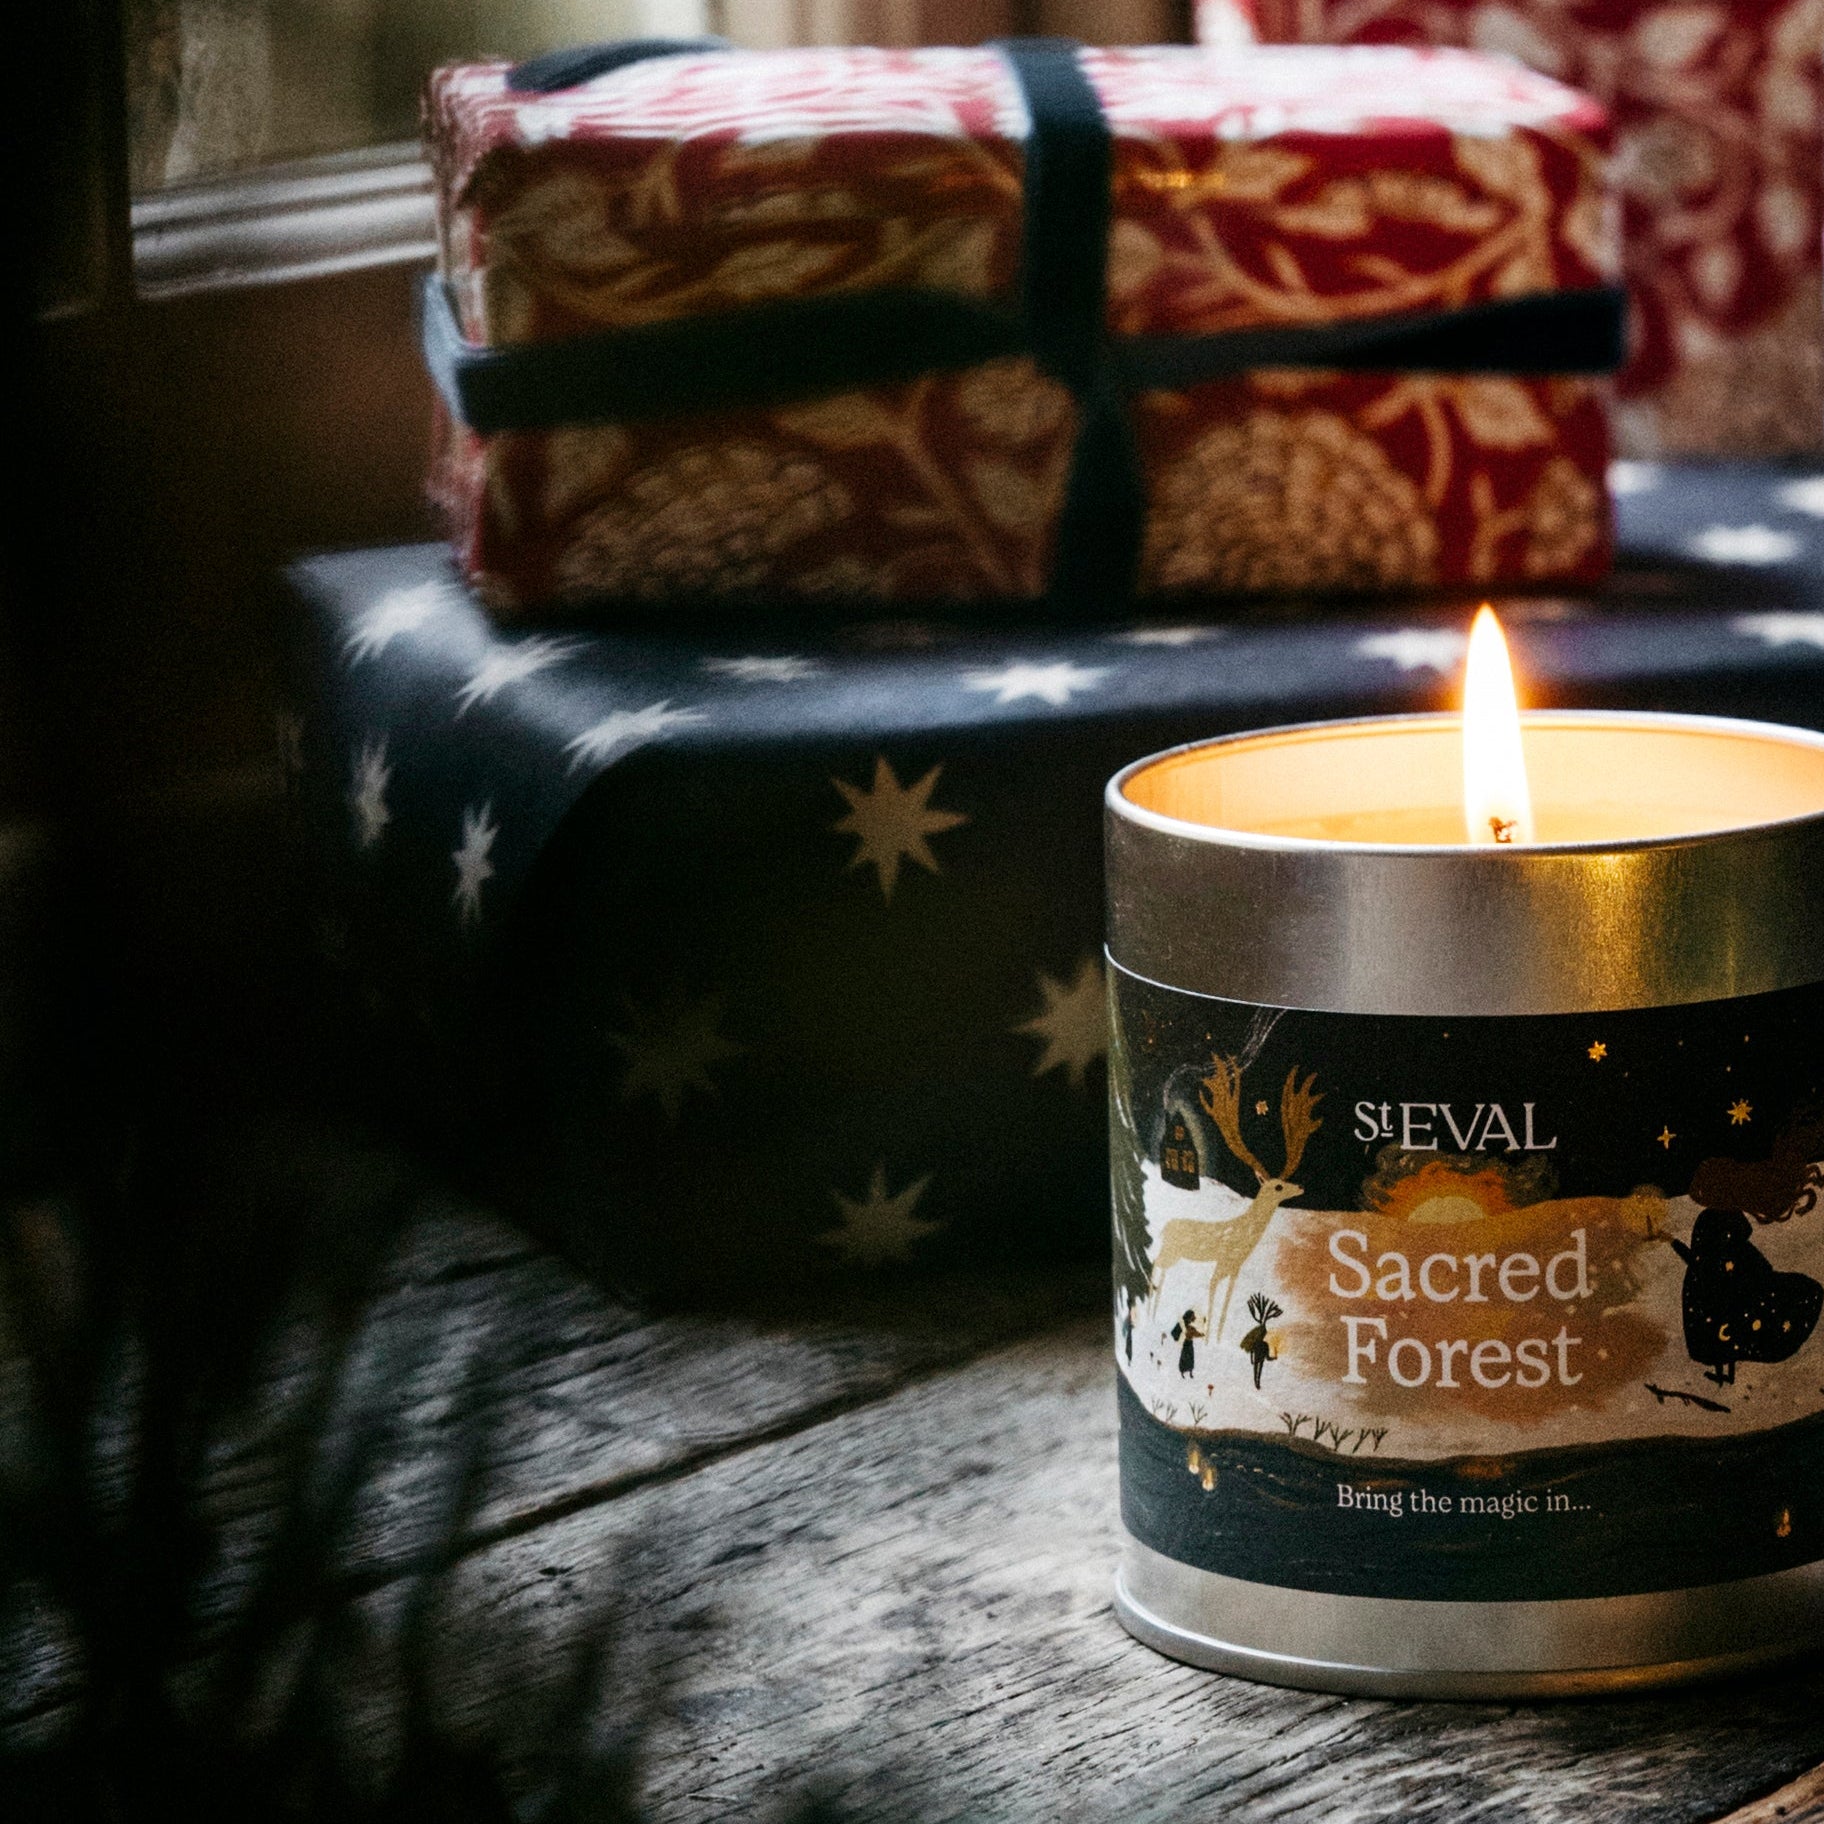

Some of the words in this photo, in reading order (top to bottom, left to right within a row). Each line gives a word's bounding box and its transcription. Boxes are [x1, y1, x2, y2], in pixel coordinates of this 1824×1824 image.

[1328, 1228, 1594, 1303] Sacred
[1340, 1315, 1584, 1389] Forest
[1336, 1483, 1404, 1518] Bring
[1410, 1488, 1453, 1514] the
[1459, 1489, 1539, 1520] magic
[1546, 1488, 1592, 1512] in...
